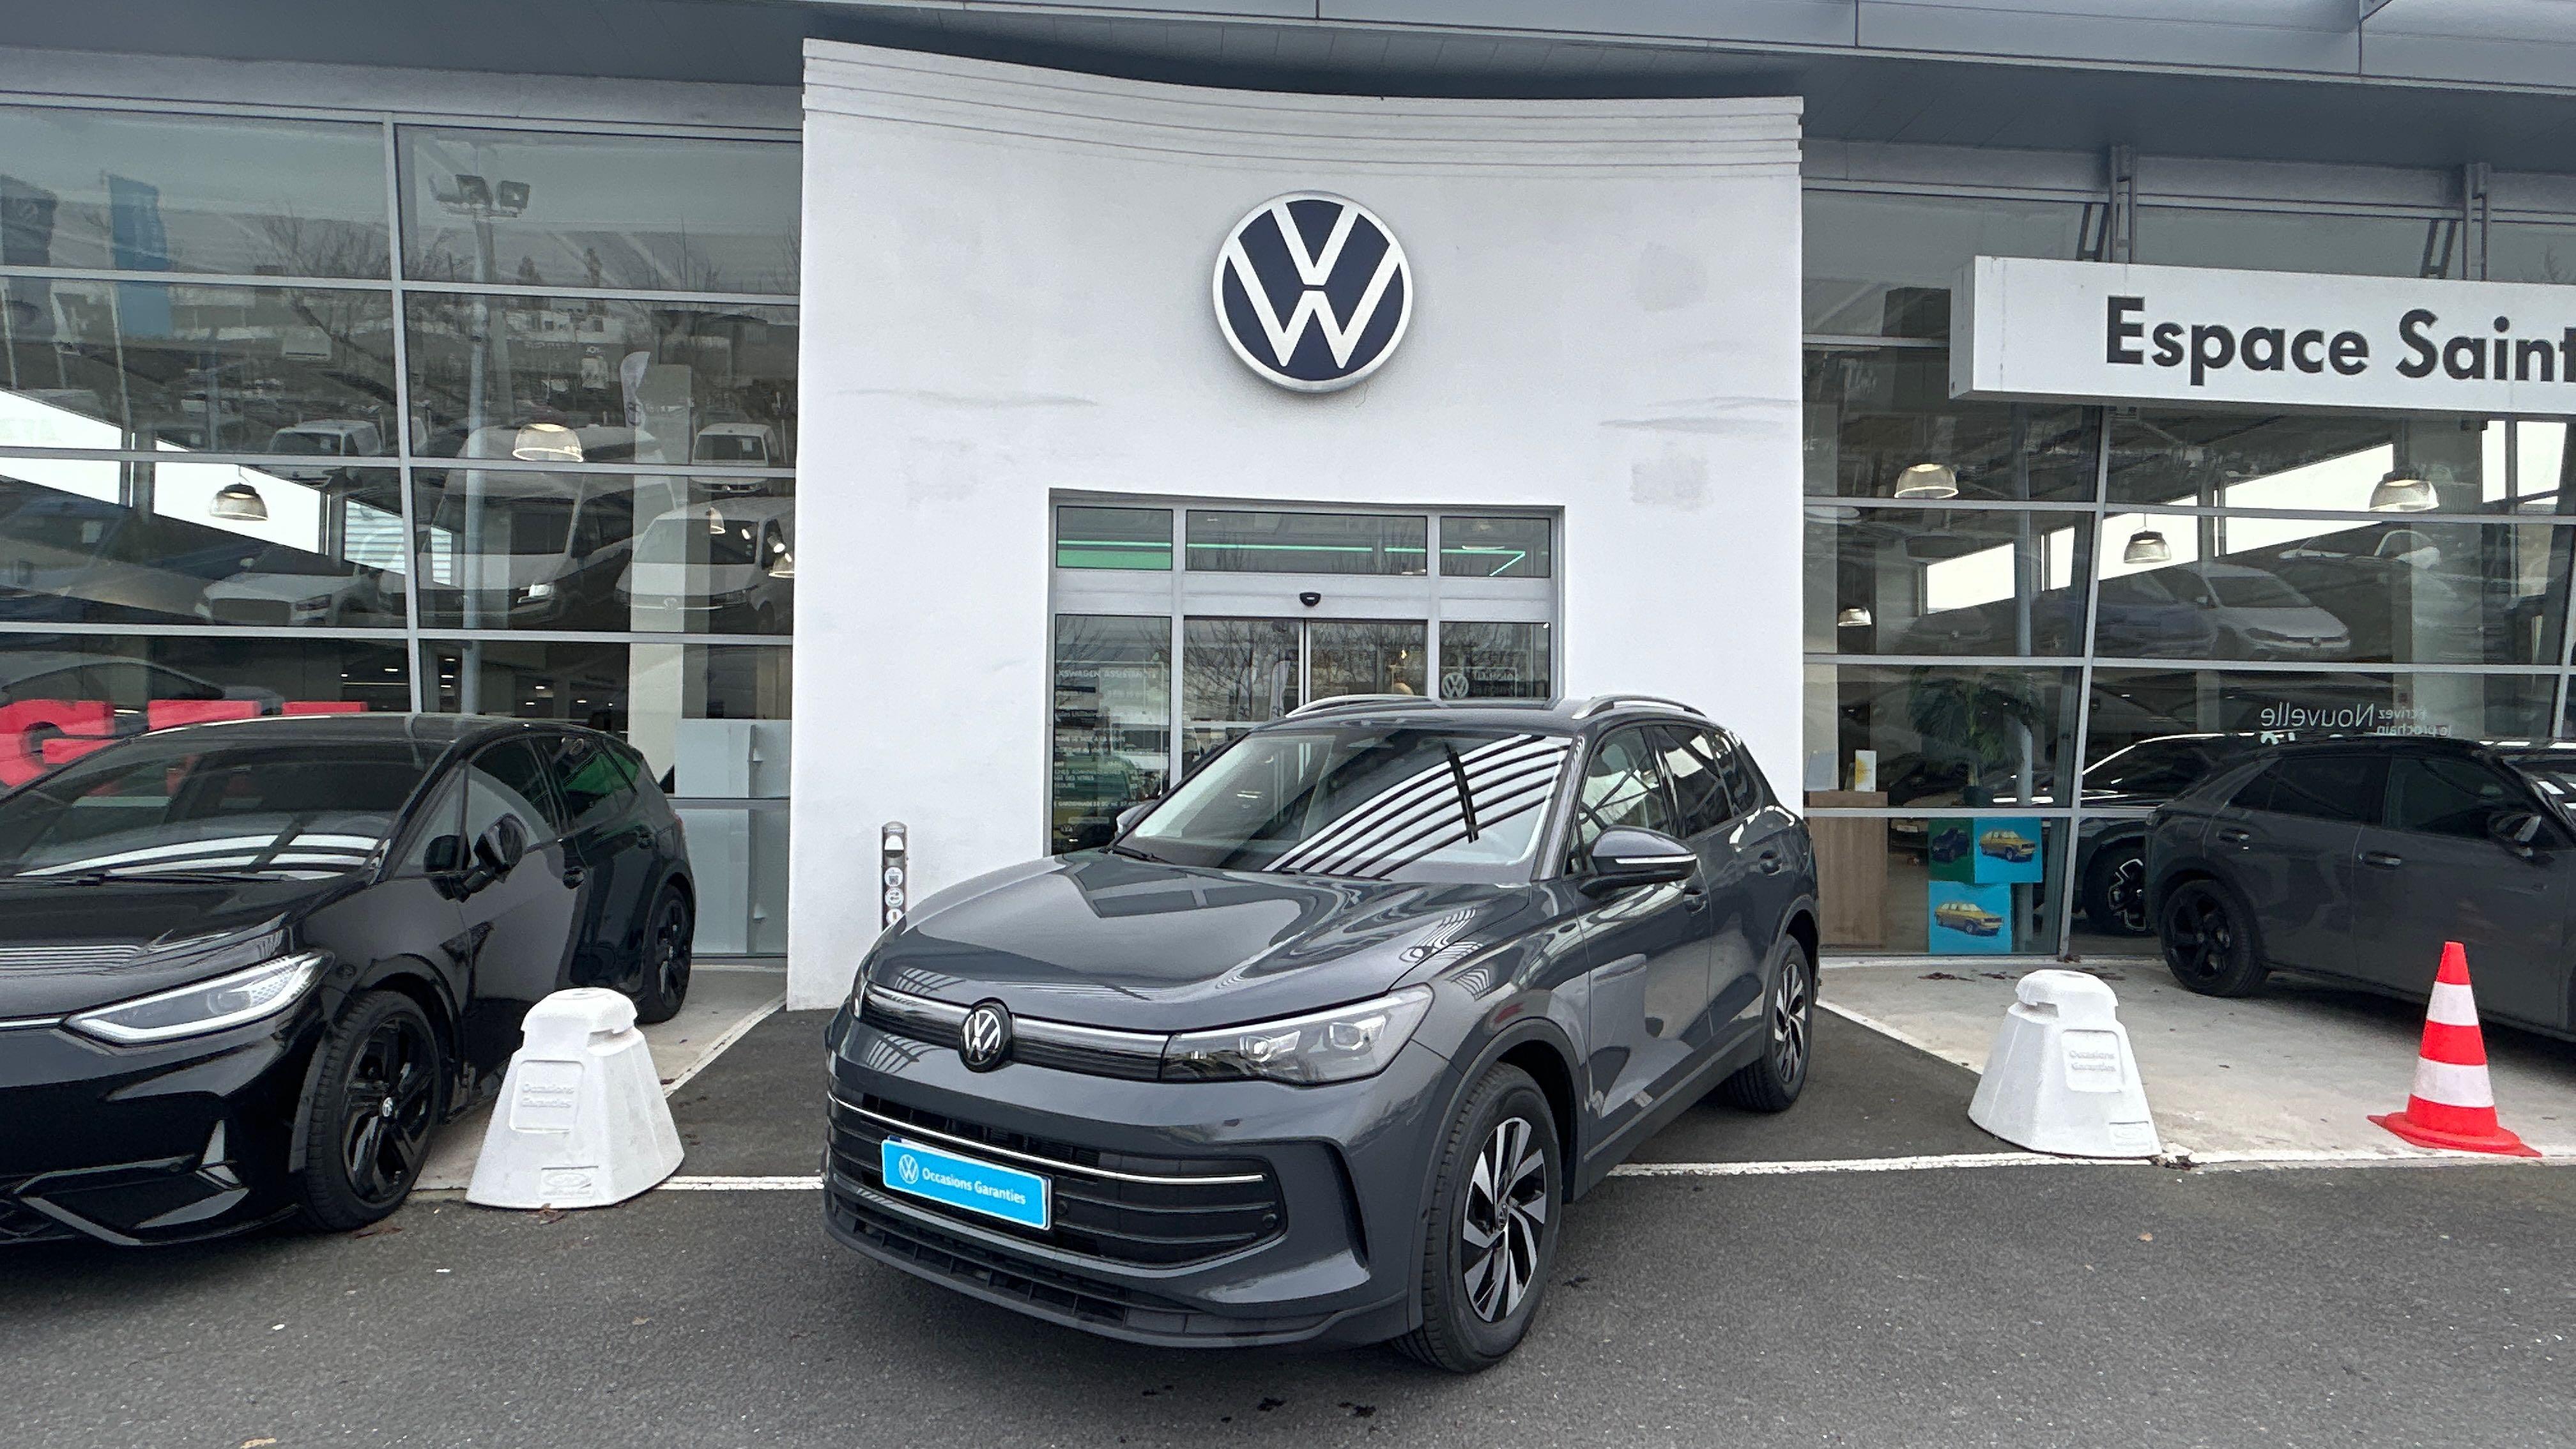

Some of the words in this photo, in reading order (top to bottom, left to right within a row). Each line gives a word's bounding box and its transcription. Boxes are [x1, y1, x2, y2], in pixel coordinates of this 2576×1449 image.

[1213, 190, 1413, 390] VW
[2107, 296, 2369, 387] Espace
[2396, 309, 2576, 383] Saint
[922, 1167, 972, 1192] Occasions
[974, 1181, 1026, 1205] Garanties
